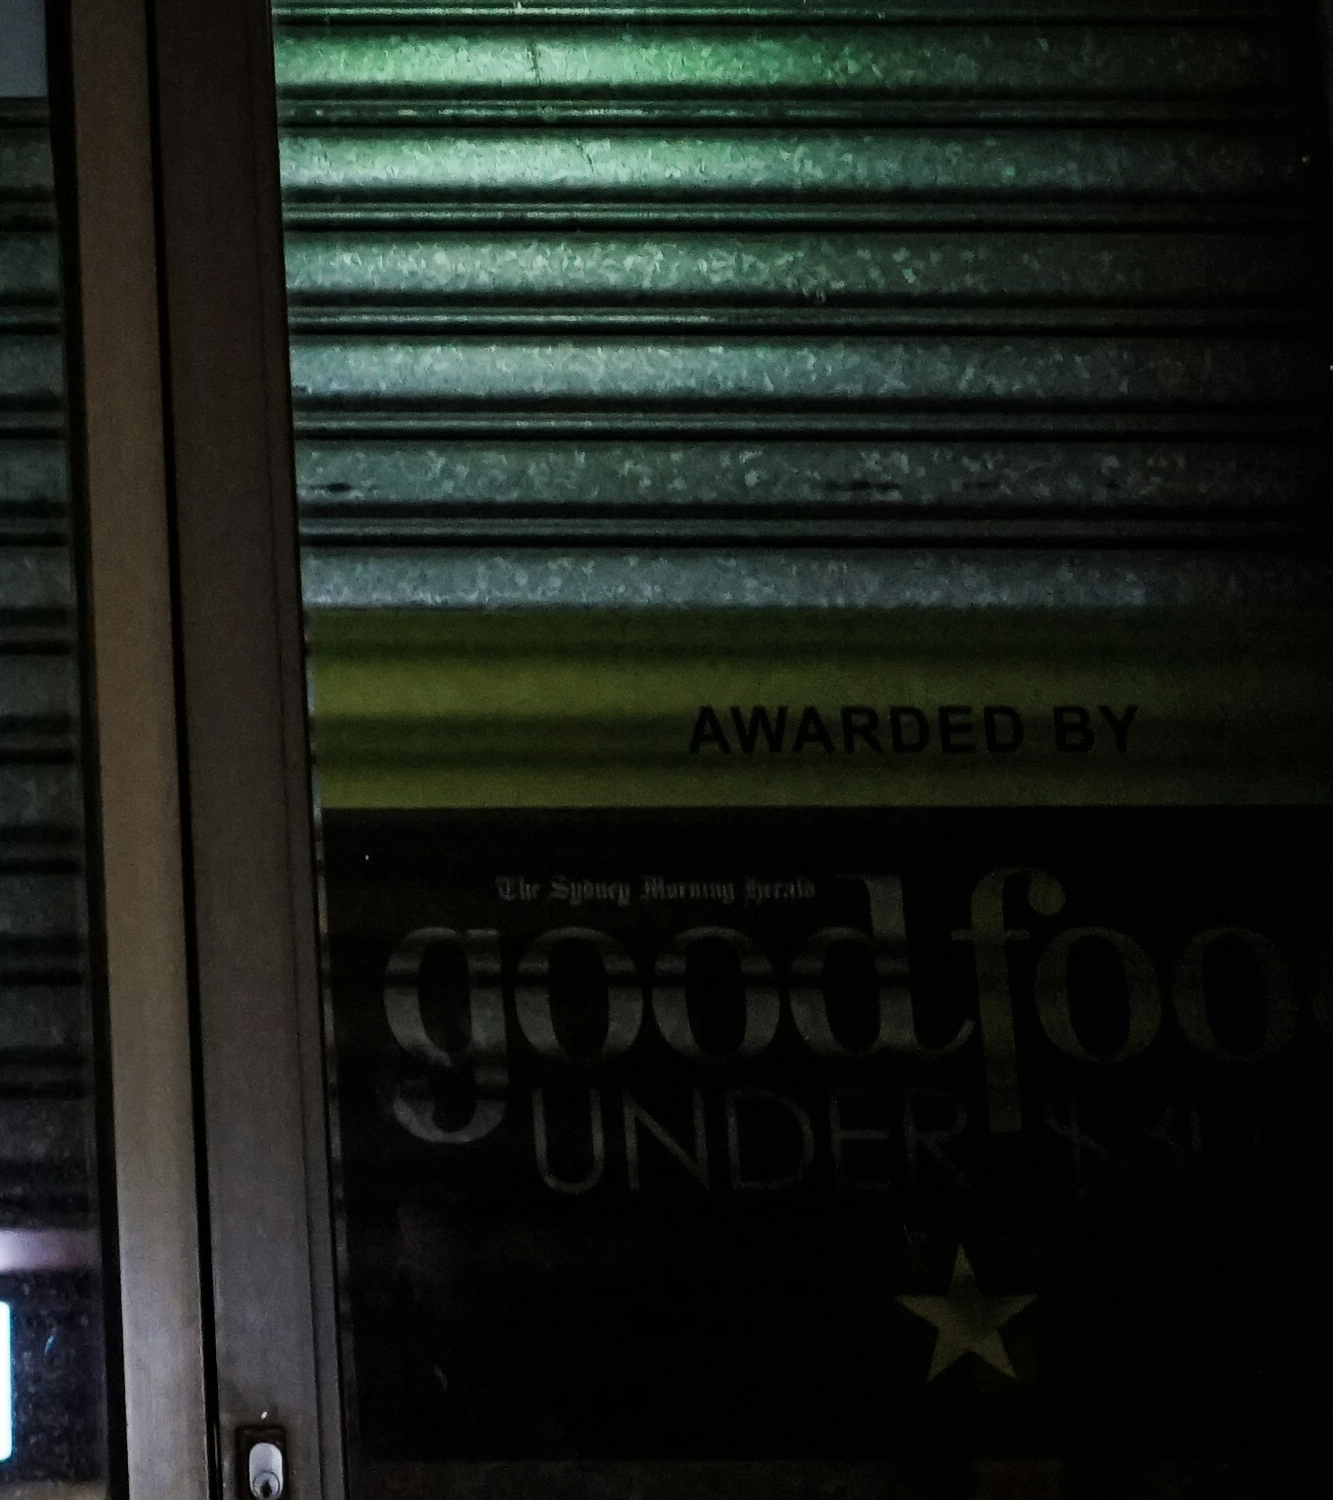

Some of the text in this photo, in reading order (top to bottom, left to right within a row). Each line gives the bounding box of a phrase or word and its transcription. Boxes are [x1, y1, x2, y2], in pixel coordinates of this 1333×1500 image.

[687, 705, 1139, 755] AWARDED BY
[494, 874, 817, 907] The Sydney Morning Herald
[533, 1088, 971, 1196] UNDER
